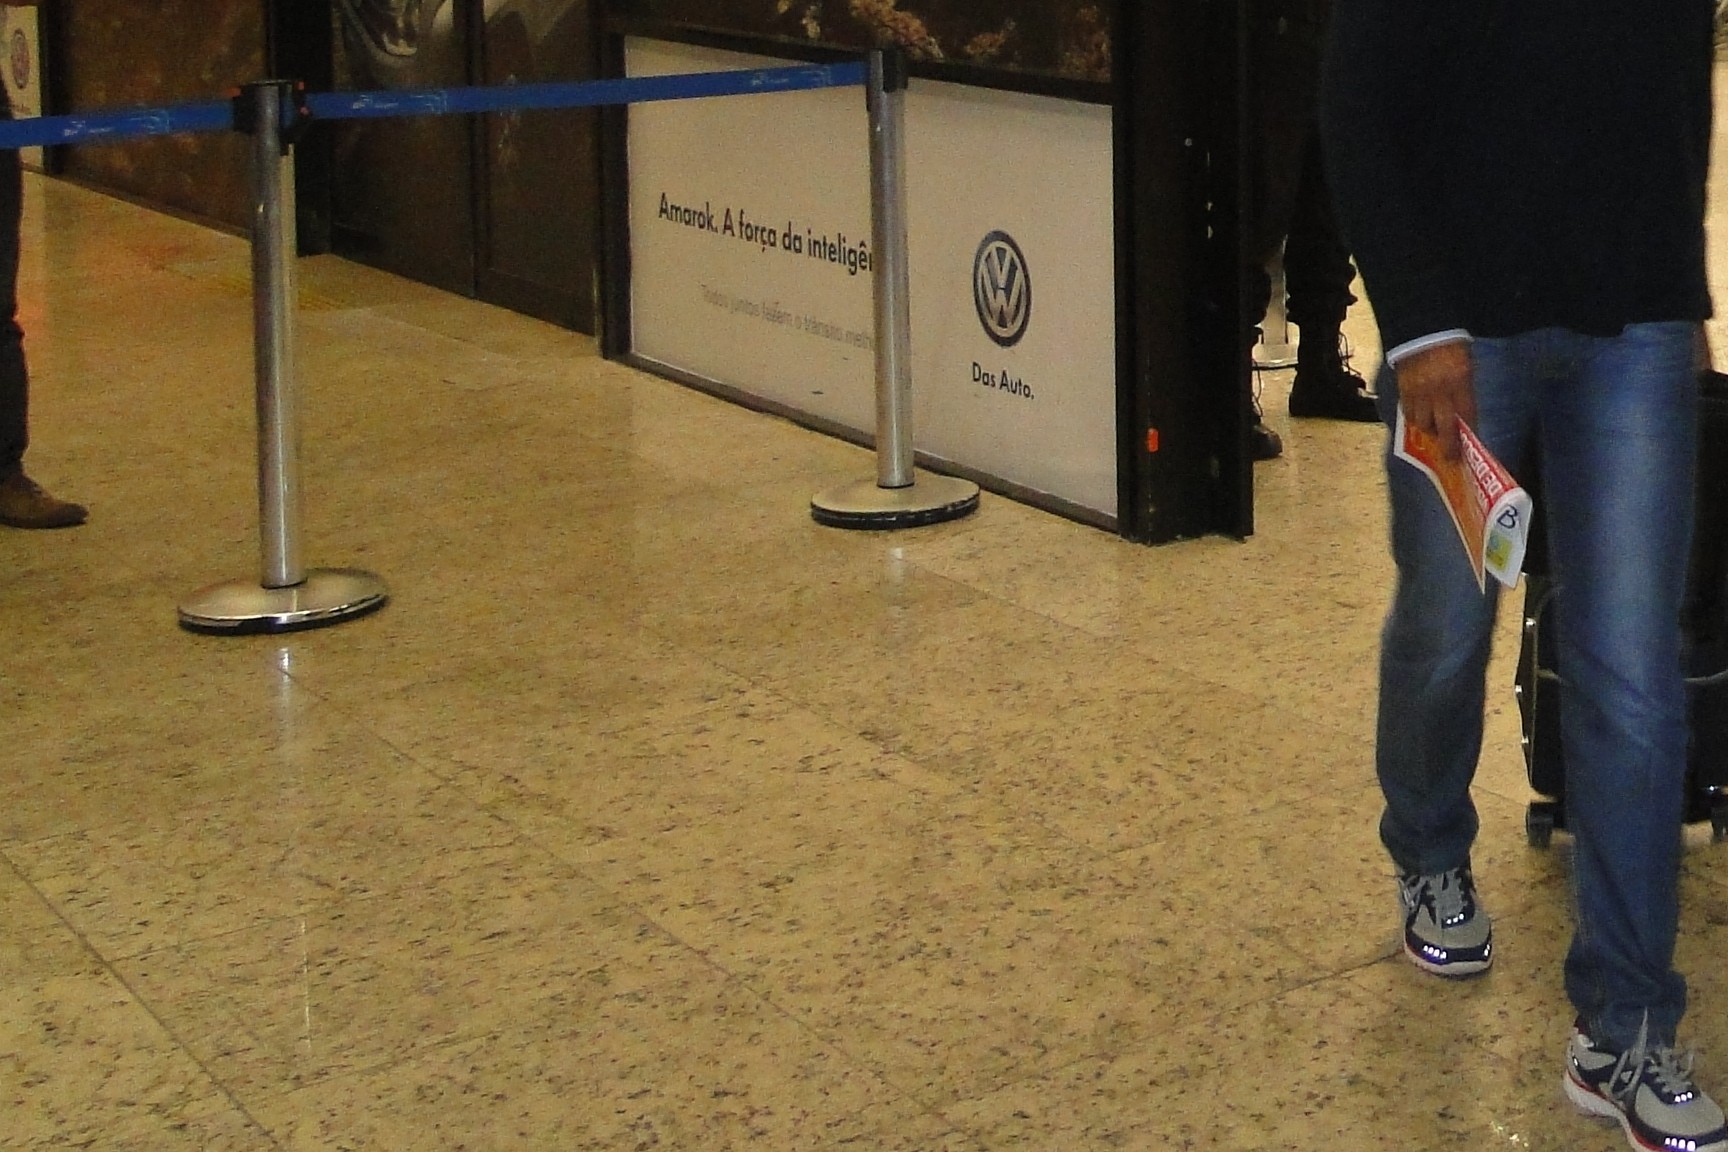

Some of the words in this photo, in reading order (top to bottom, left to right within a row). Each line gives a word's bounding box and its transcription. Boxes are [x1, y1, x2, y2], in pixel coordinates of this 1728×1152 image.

[658, 191, 719, 234] Amarok.
[722, 207, 735, 238] A
[738, 209, 777, 253] força
[782, 220, 802, 255] da
[972, 360, 996, 389] Das
[998, 369, 1036, 401] Auto.
